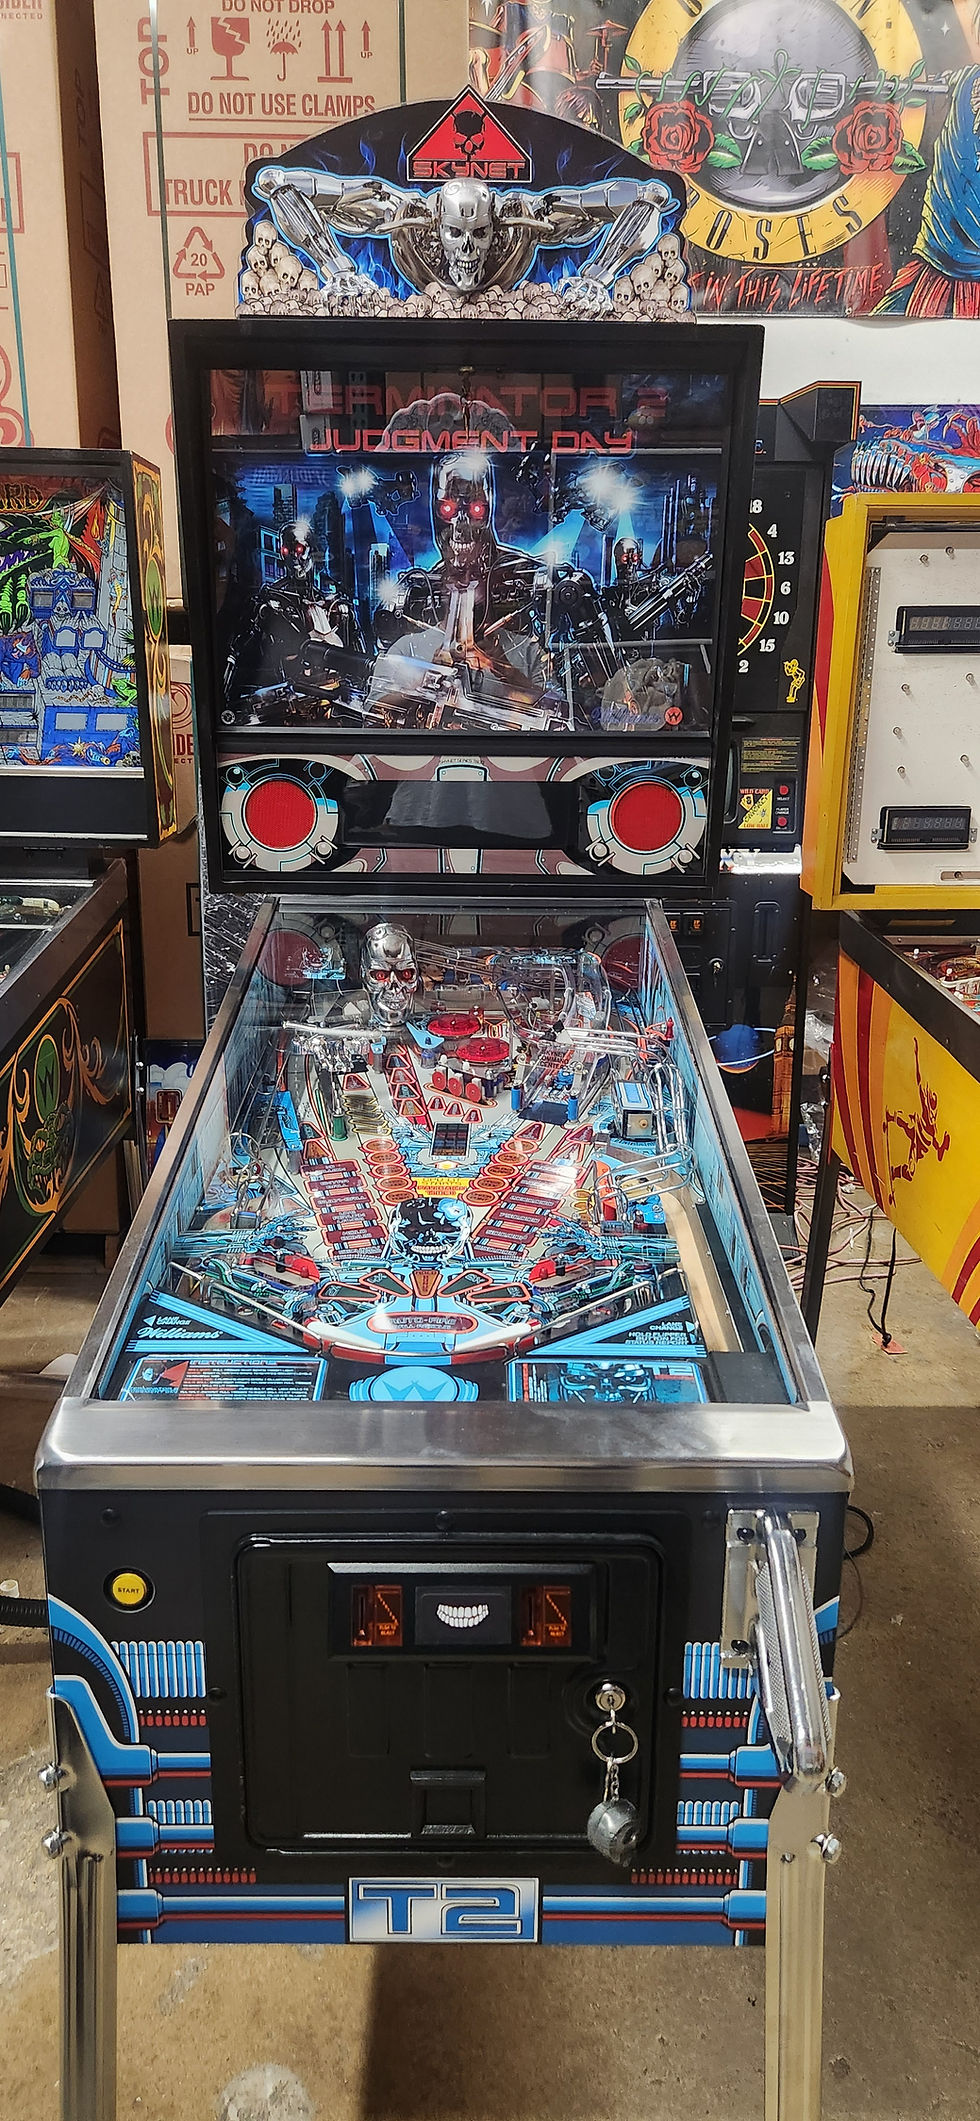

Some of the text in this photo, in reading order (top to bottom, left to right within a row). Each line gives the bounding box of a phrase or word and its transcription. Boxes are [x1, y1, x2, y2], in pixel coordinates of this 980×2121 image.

[222, 0, 335, 14] DO NOT DROP
[138, 17, 169, 105] TOP
[188, 91, 376, 117] DO NOT USE CLAMPS
[413, 161, 526, 179] SKYNET
[163, 179, 232, 206] TRUCK
[190, 253, 208, 268] 20
[185, 282, 215, 297] PAP
[703, 271, 732, 311] IN
[735, 265, 783, 313] THIS
[788, 262, 884, 311] LIFETIME
[264, 384, 617, 418] TERMINATOR
[309, 428, 633, 454] JUDGMENT DAY
[767, 523, 778, 538] 4
[778, 551, 795, 566] 13
[780, 581, 791, 595] 6
[773, 611, 790, 625] 10
[759, 638, 776, 653] 15
[738, 659, 749, 674] 2
[137, 1327, 222, 1339] Williams
[358, 1884, 522, 1934] T2
